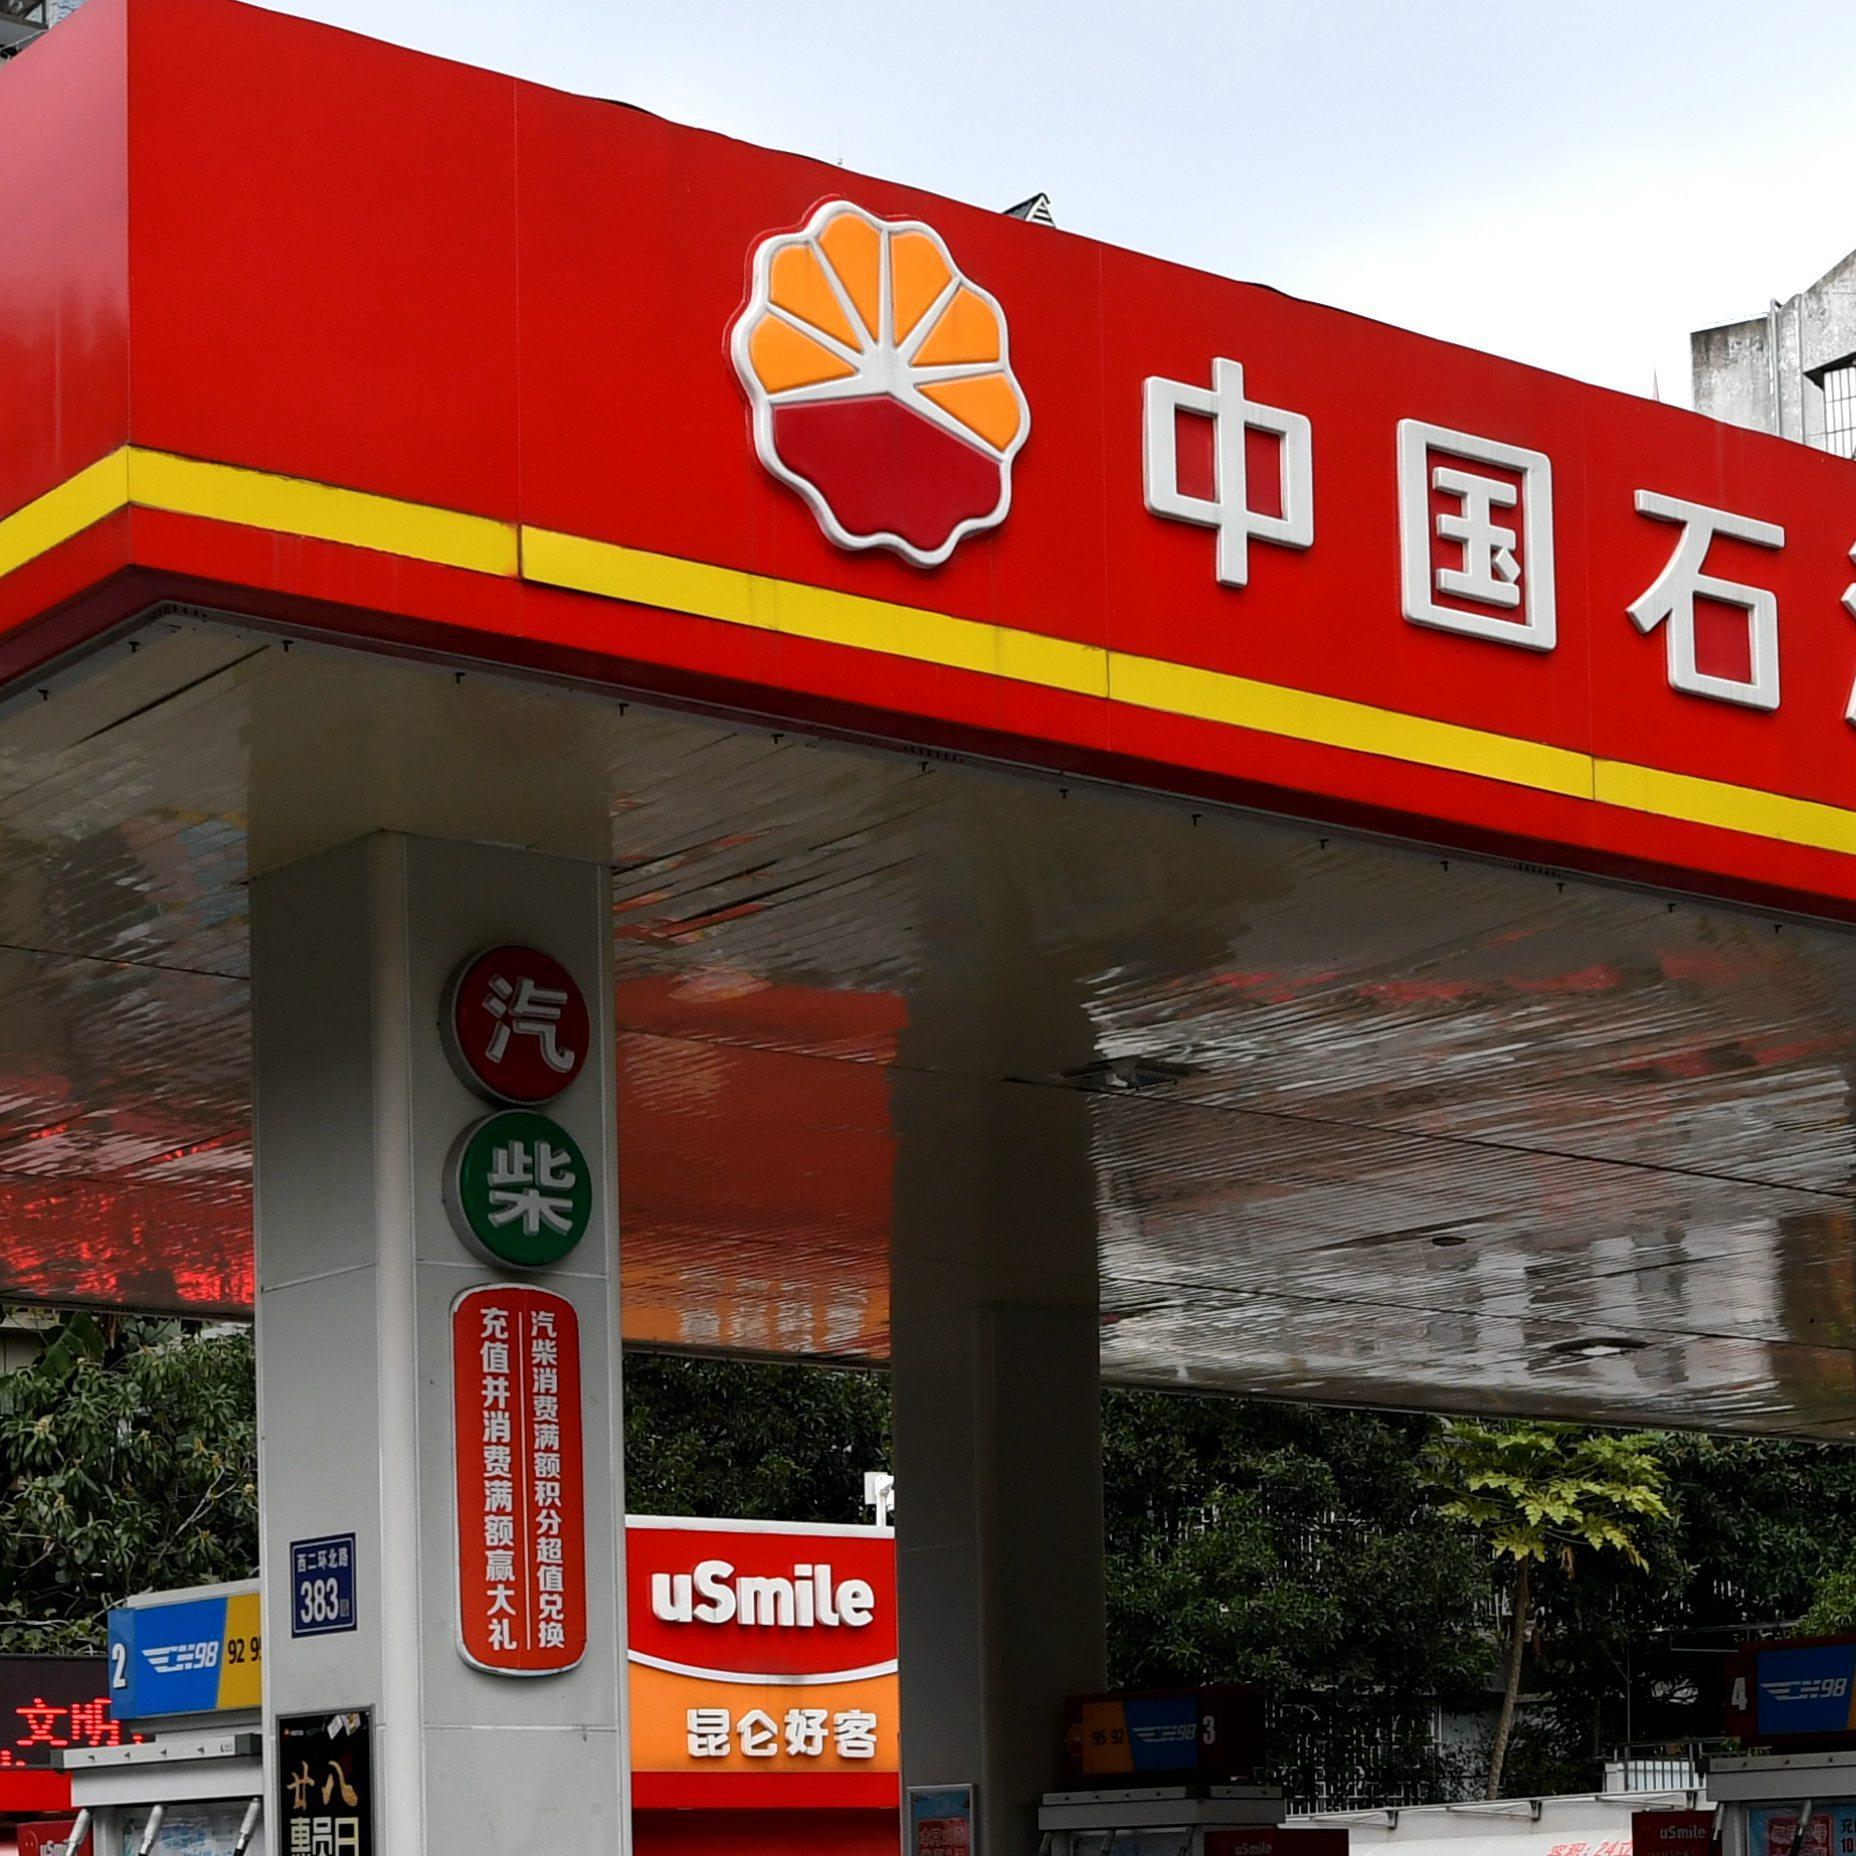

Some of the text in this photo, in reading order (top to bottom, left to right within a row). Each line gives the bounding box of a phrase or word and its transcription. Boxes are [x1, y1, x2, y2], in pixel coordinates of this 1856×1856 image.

[482, 974, 576, 1075] 汽
[486, 1139, 576, 1236] 柴
[479, 1306, 518, 1651] 充值并消费满额赢大礼
[530, 1310, 565, 1650] 汽柴消费满额积分超值兑换
[297, 1546, 349, 1574] 西二环北路
[651, 1558, 876, 1629] uSmile
[111, 1643, 129, 1690] 2
[227, 1637, 246, 1664] 92
[685, 1707, 879, 1760] 昆仑好客
[1202, 1715, 1216, 1744] 3
[1235, 1841, 1273, 1855] uSmile
[1659, 1824, 1706, 1840] uSmile
